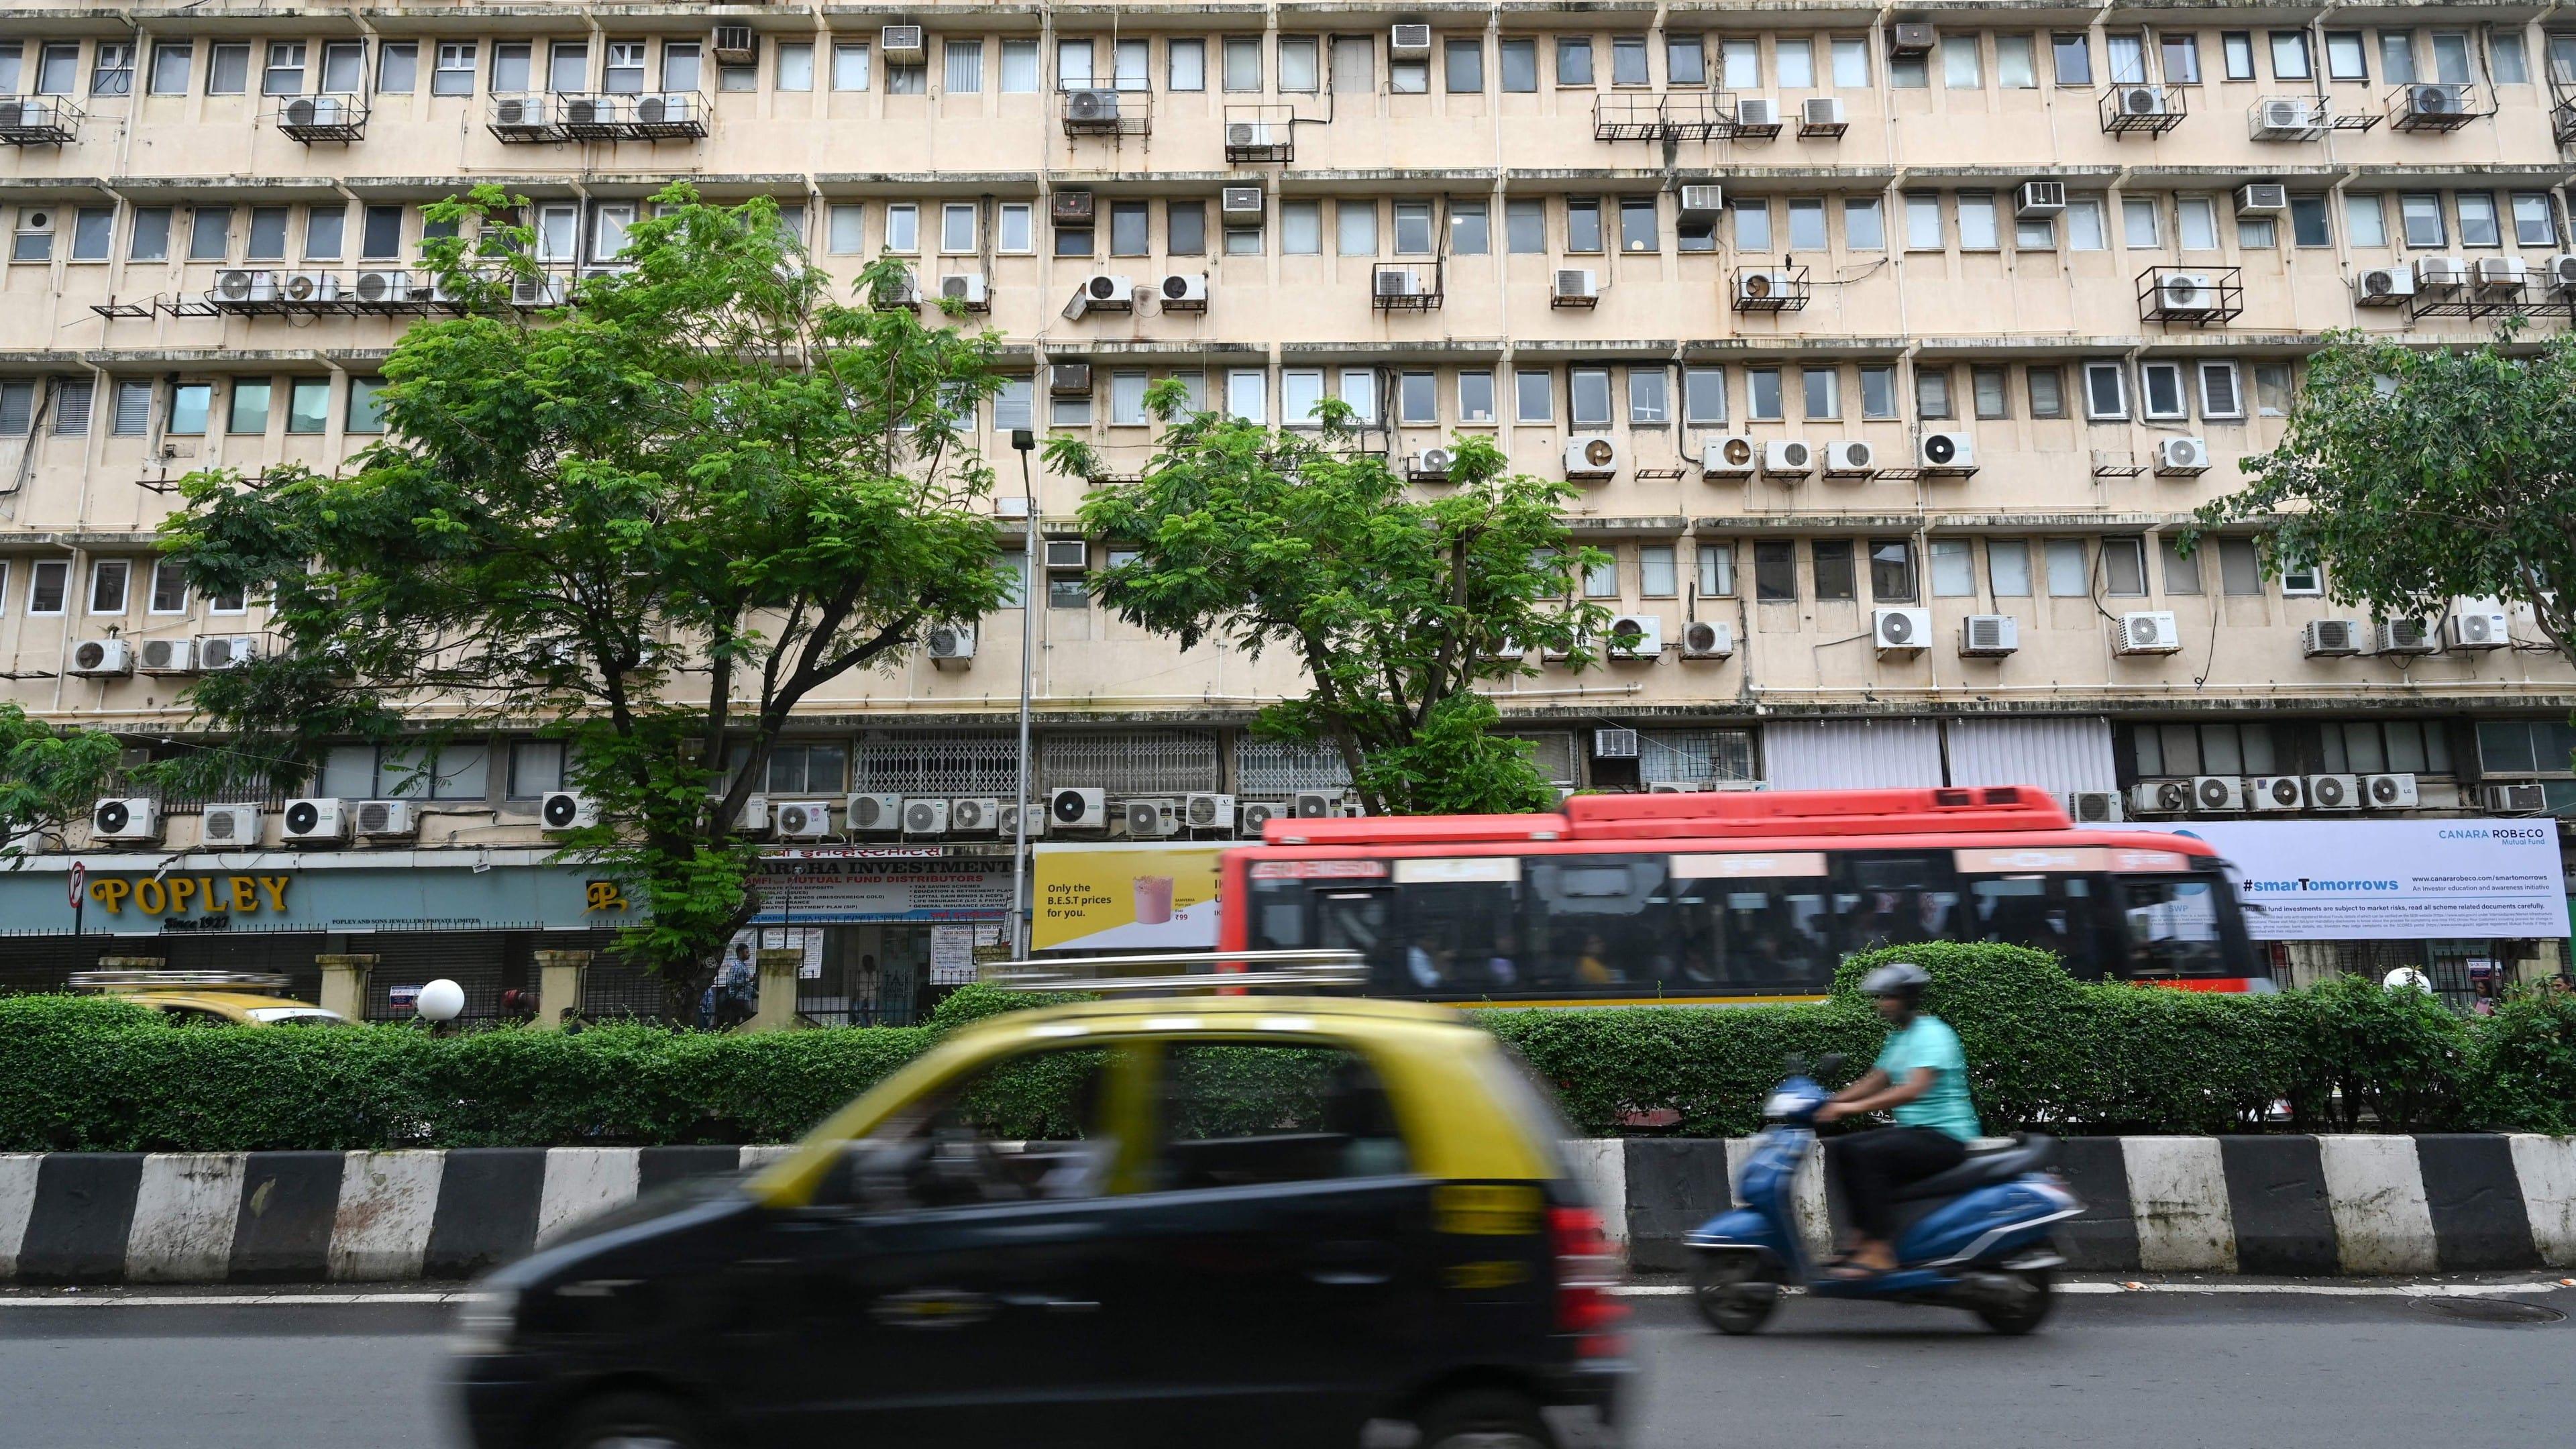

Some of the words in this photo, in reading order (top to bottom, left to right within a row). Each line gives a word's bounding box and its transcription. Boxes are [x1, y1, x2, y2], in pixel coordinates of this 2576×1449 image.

[2439, 829, 2489, 839] CANARA
[2492, 829, 2544, 839] ROBECO
[847, 860, 1028, 874] INVESTMENT
[745, 877, 771, 885] AMFI
[787, 876, 842, 884] MUTUAL
[886, 875, 983, 883] DISTRIBUTORS
[2412, 875, 2548, 883] www.canararobeco.com/smartomorrows
[1048, 884, 1071, 895] Only
[1073, 883, 1091, 892] the
[2243, 878, 2399, 892] #smarTomorrows
[89, 876, 289, 914] POPLEY
[1048, 896, 1079, 905] B.E.S.T
[1081, 896, 1112, 907] prices
[1047, 909, 1062, 917] for
[1064, 910, 1086, 920] you.
[164, 916, 198, 929] Since
